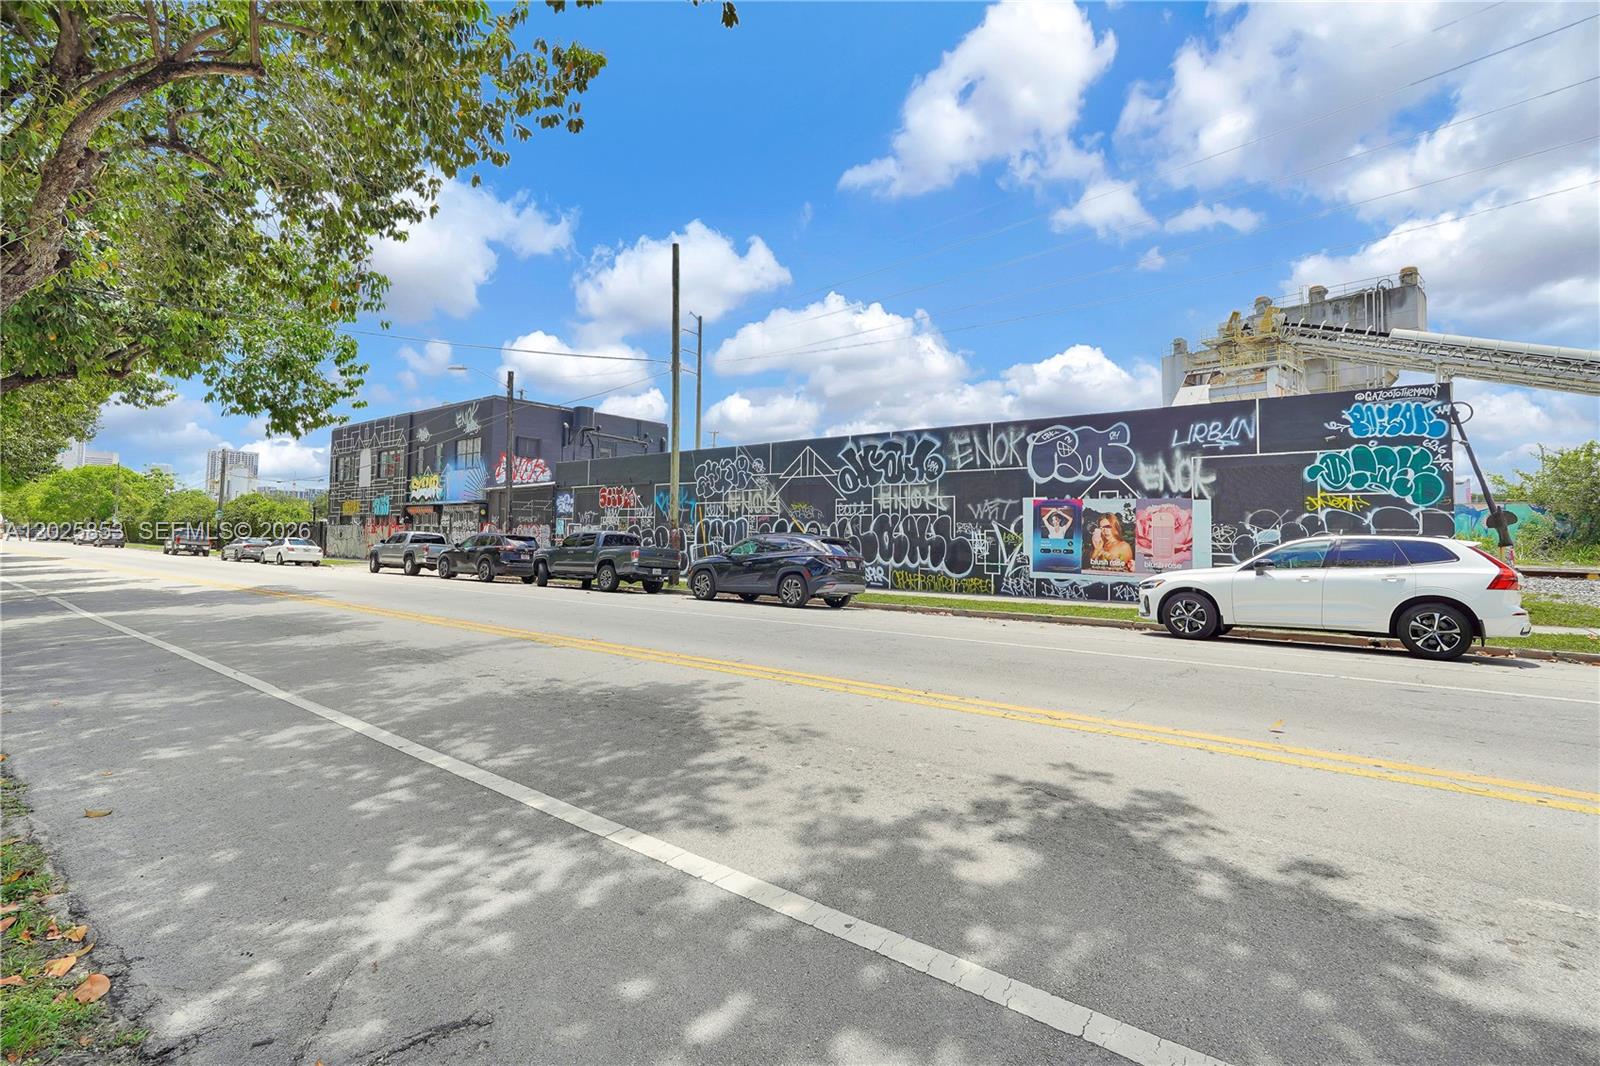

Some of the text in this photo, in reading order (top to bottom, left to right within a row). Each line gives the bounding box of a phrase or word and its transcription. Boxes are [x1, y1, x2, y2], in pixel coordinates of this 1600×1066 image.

[950, 428, 1027, 470] ENOK
[1171, 412, 1256, 447] URBAN
[1138, 452, 1217, 500] ENOK
